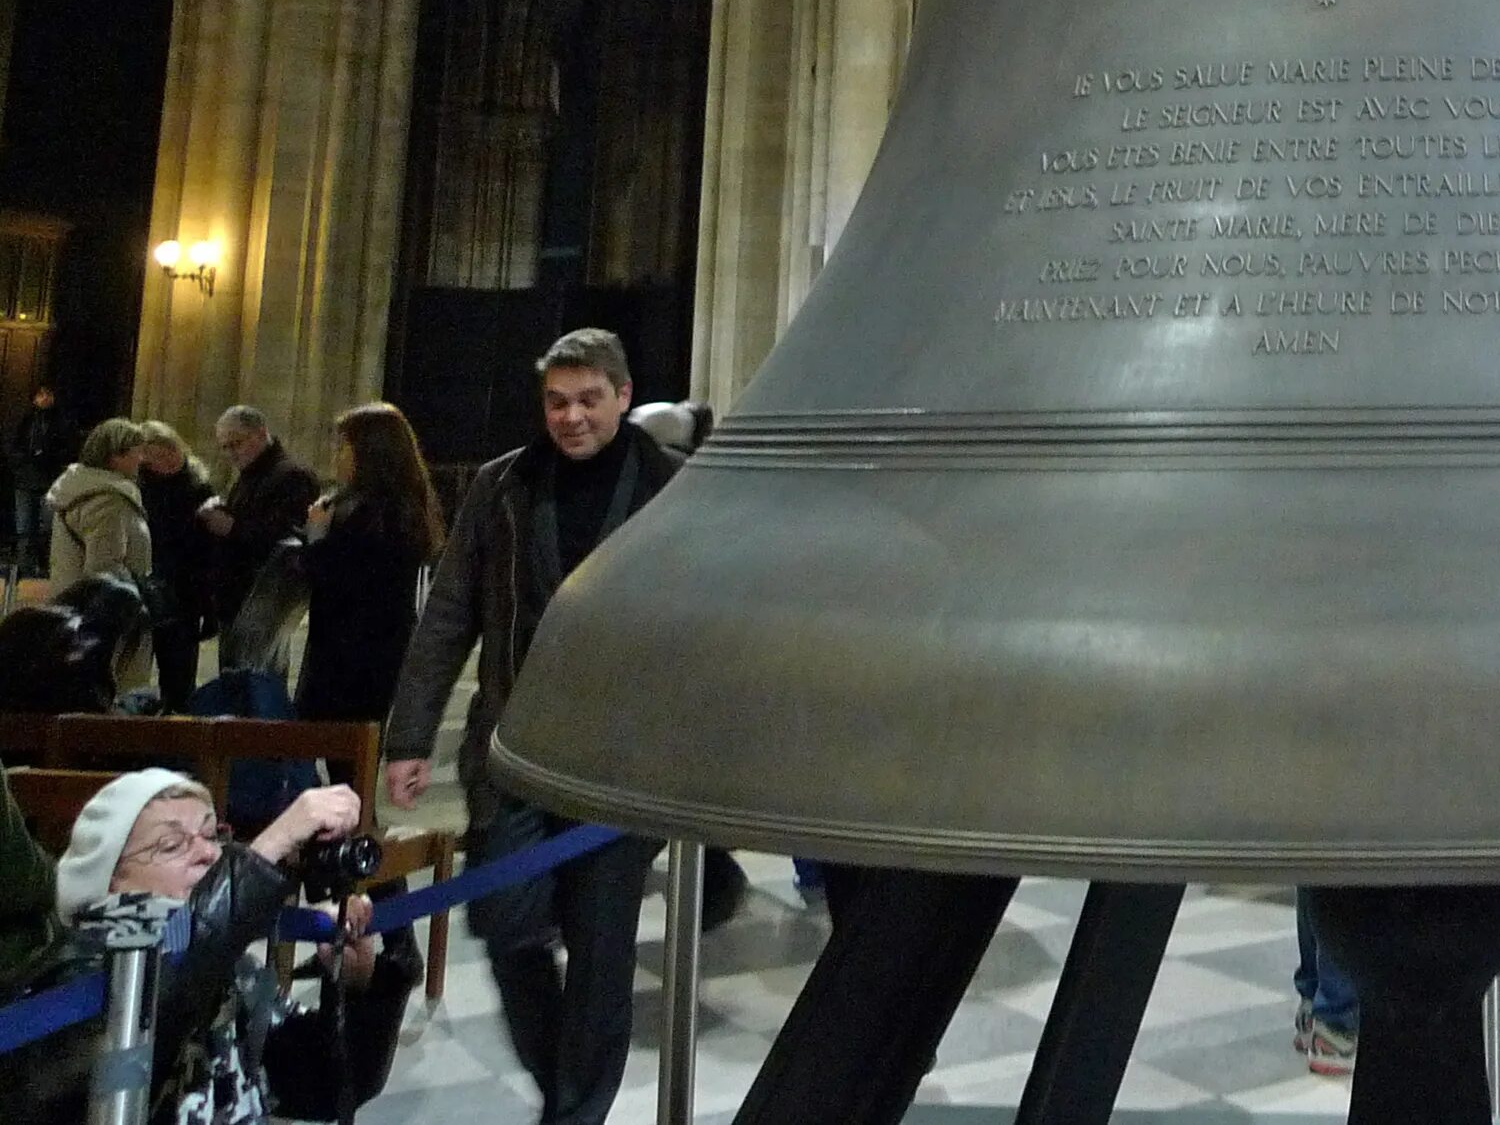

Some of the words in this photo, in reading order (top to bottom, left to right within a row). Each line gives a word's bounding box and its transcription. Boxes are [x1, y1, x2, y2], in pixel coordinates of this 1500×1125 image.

[1103, 70, 1163, 92] VOUS
[1173, 62, 1252, 90] SALUE
[1267, 59, 1350, 84] MARIE
[1362, 58, 1453, 83] PLEINE
[1120, 108, 1149, 132] LE
[1159, 100, 1282, 128] SEIGNEUR
[1296, 99, 1343, 124] EST
[1355, 97, 1430, 121] AVEC
[1041, 147, 1099, 174] VOUS
[1105, 143, 1161, 171] ETES
[1169, 139, 1241, 166] BENIE
[1252, 137, 1337, 164] ENTRE
[1355, 135, 1468, 159] TOUTES
[1110, 182, 1137, 206] LE
[1147, 177, 1223, 203] FRUIT
[1236, 177, 1270, 200] DE
[1286, 176, 1343, 199] VOS
[1109, 217, 1200, 244] SAINTE
[1313, 212, 1387, 237] MERE
[1402, 212, 1439, 236] DE
[1113, 253, 1188, 281] POUR
[1296, 250, 1430, 276] PAUVRES
[993, 292, 1165, 324] MAINTENANT
[1172, 292, 1211, 317] ET
[1221, 293, 1243, 317] A
[1389, 291, 1426, 315] DE
[1252, 329, 1341, 356] AMEN
